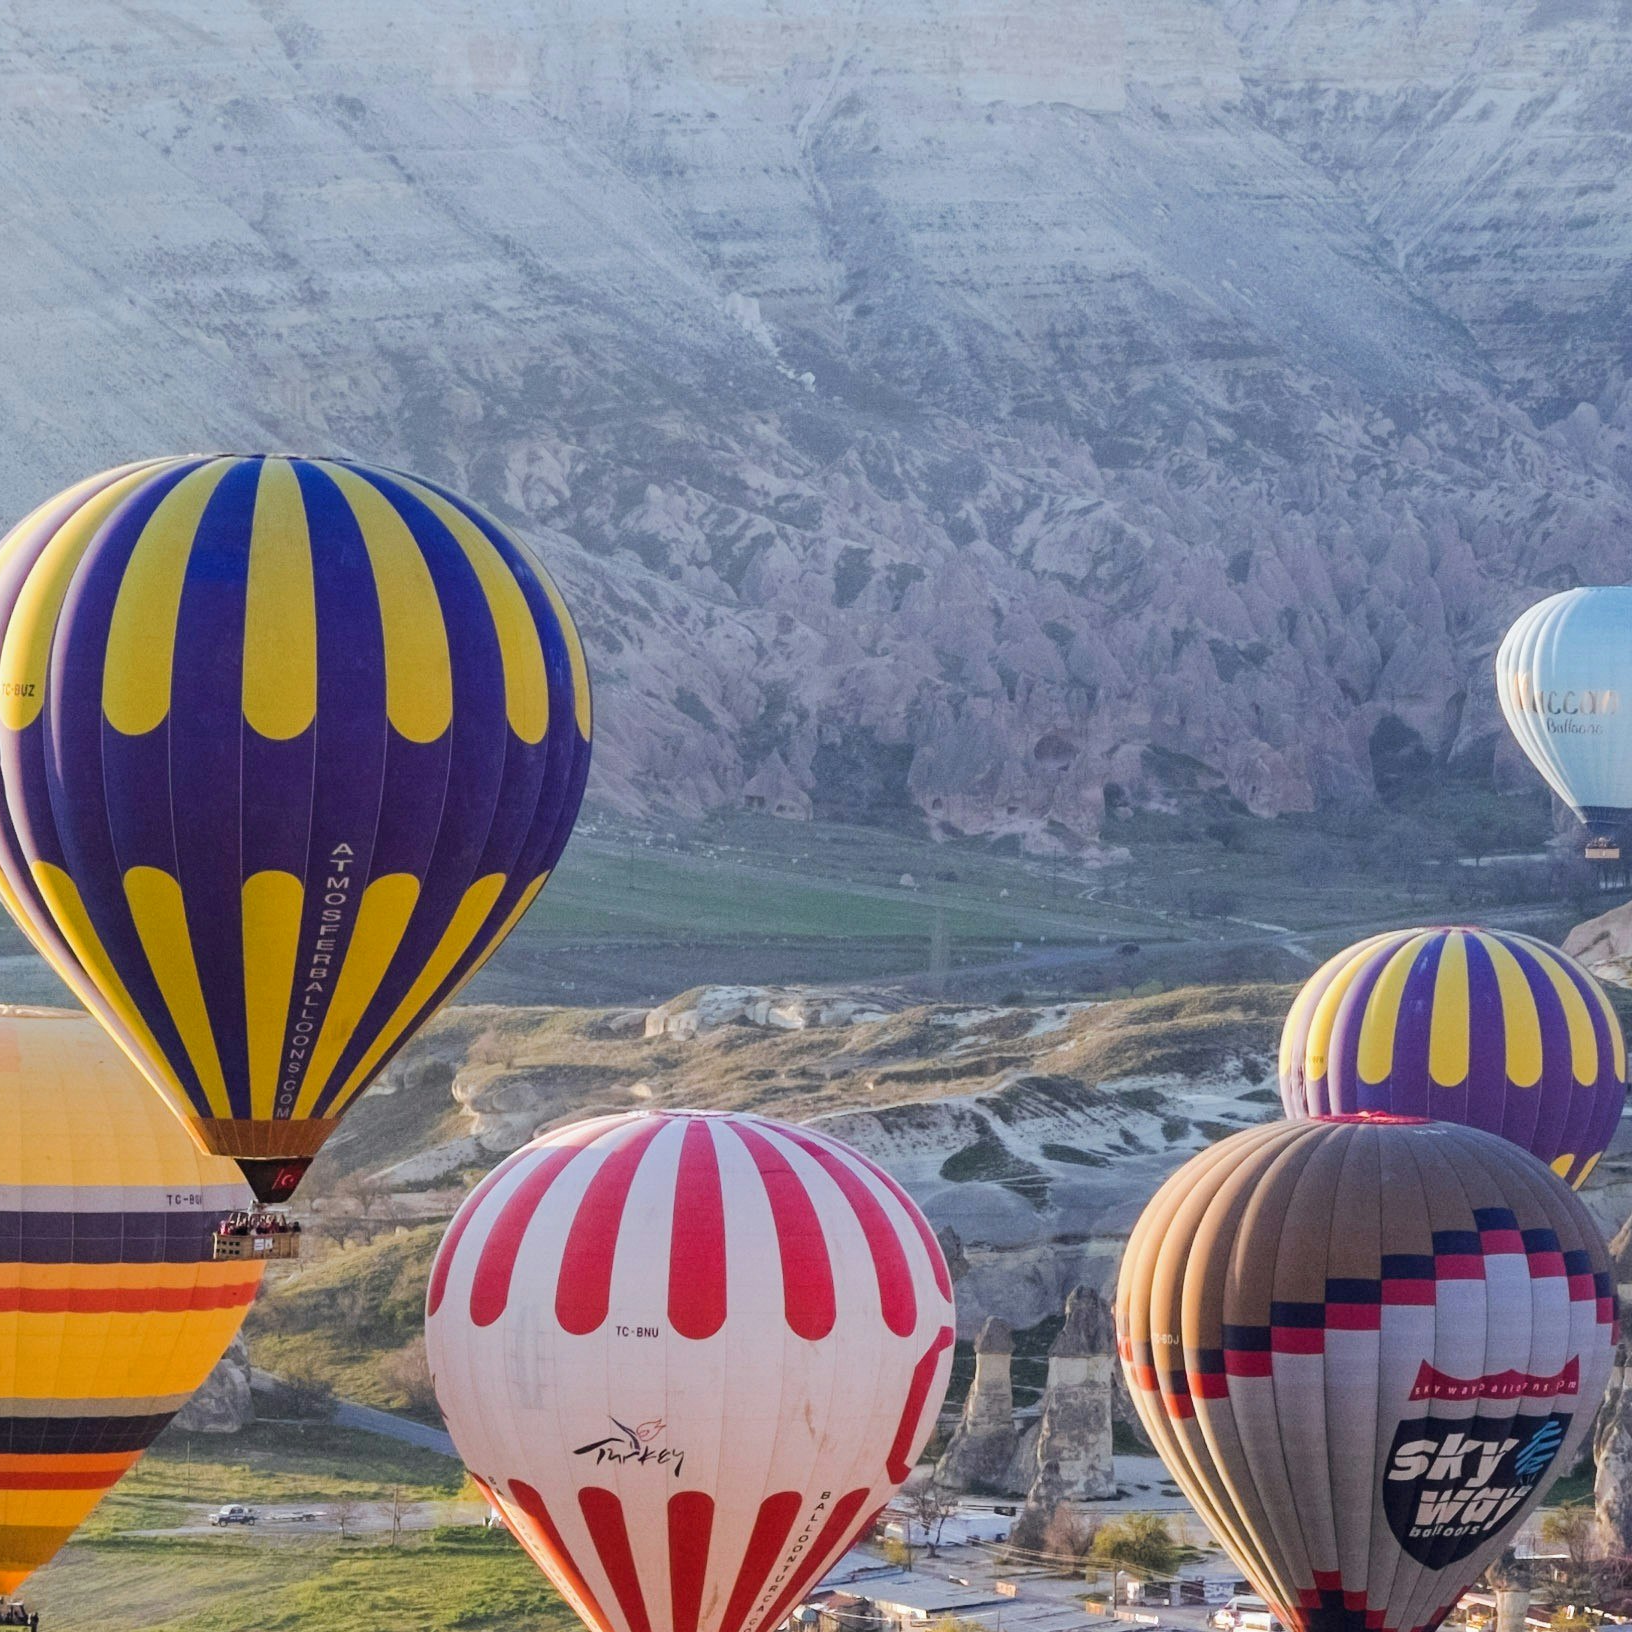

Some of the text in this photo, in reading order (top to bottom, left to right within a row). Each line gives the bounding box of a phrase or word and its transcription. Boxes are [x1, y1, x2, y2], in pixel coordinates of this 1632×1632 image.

[276, 842, 354, 1119] ATMOSFERBALLOONS.COM
[616, 1325, 659, 1338] TC-BNU
[573, 1430, 685, 1478] Turkey
[1388, 1433, 1519, 1488] sky
[1415, 1486, 1533, 1531] way
